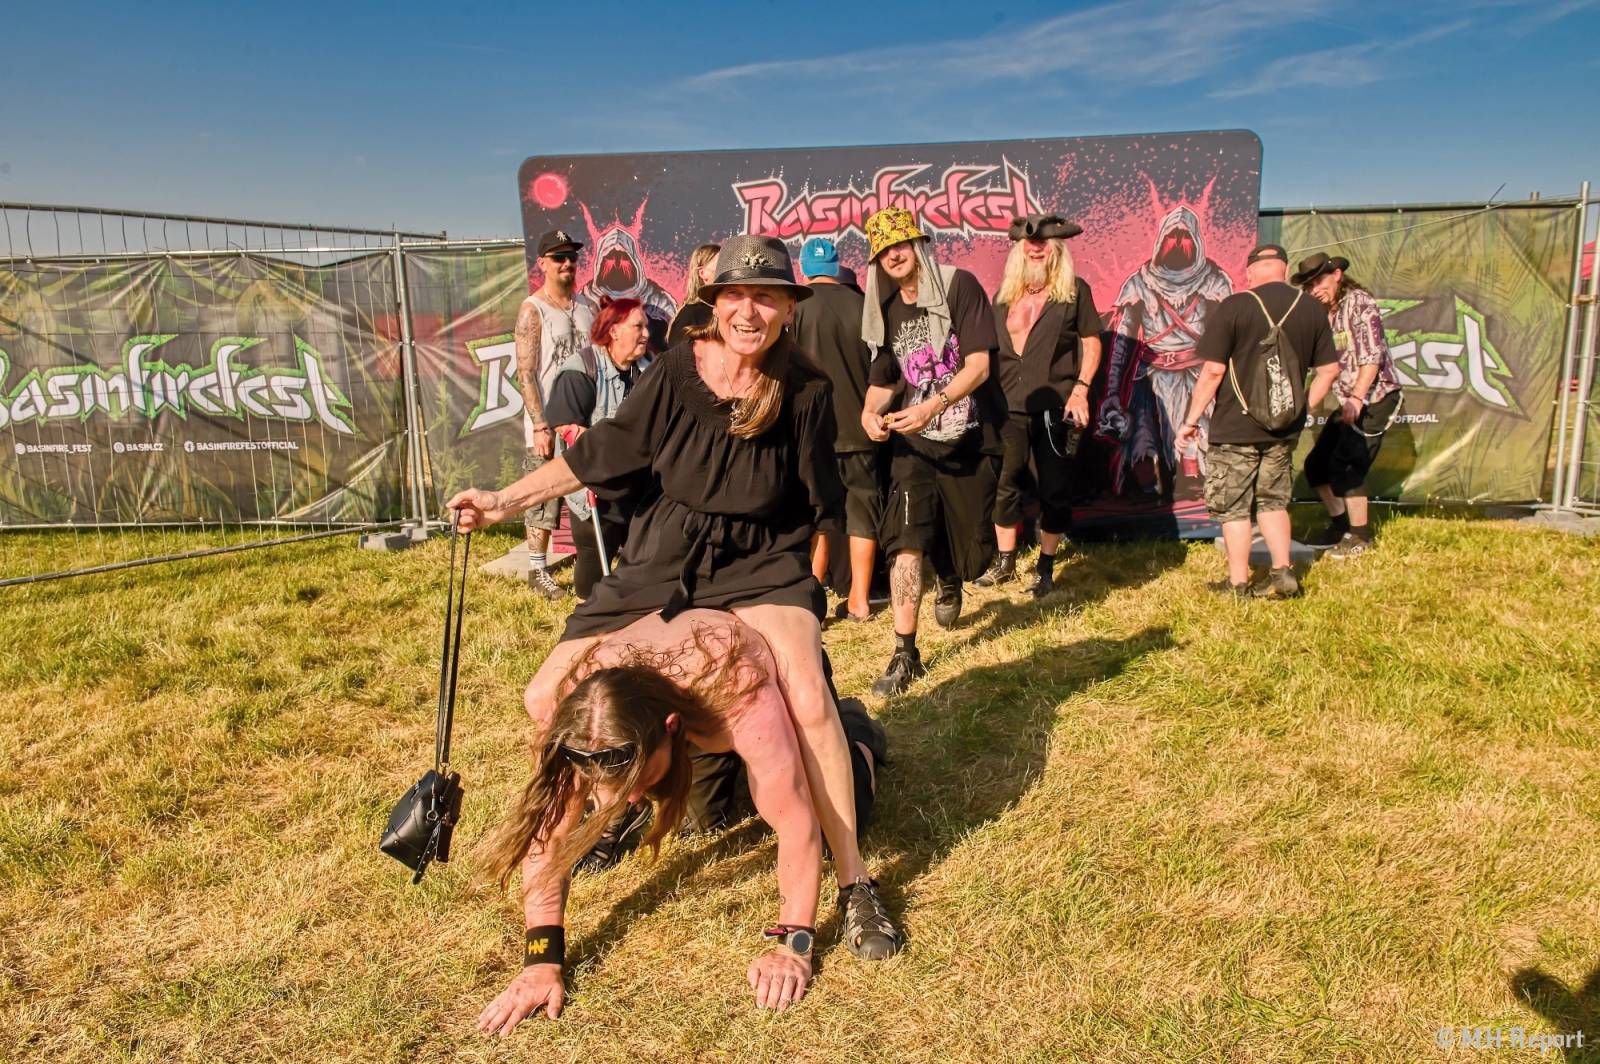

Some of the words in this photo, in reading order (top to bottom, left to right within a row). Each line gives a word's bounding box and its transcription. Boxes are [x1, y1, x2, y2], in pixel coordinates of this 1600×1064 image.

[0, 335, 358, 435] asinfirefest
[26, 444, 93, 454] BASINFIRE_FEST
[196, 441, 299, 451] BASINFIREFESTOFFICIAL
